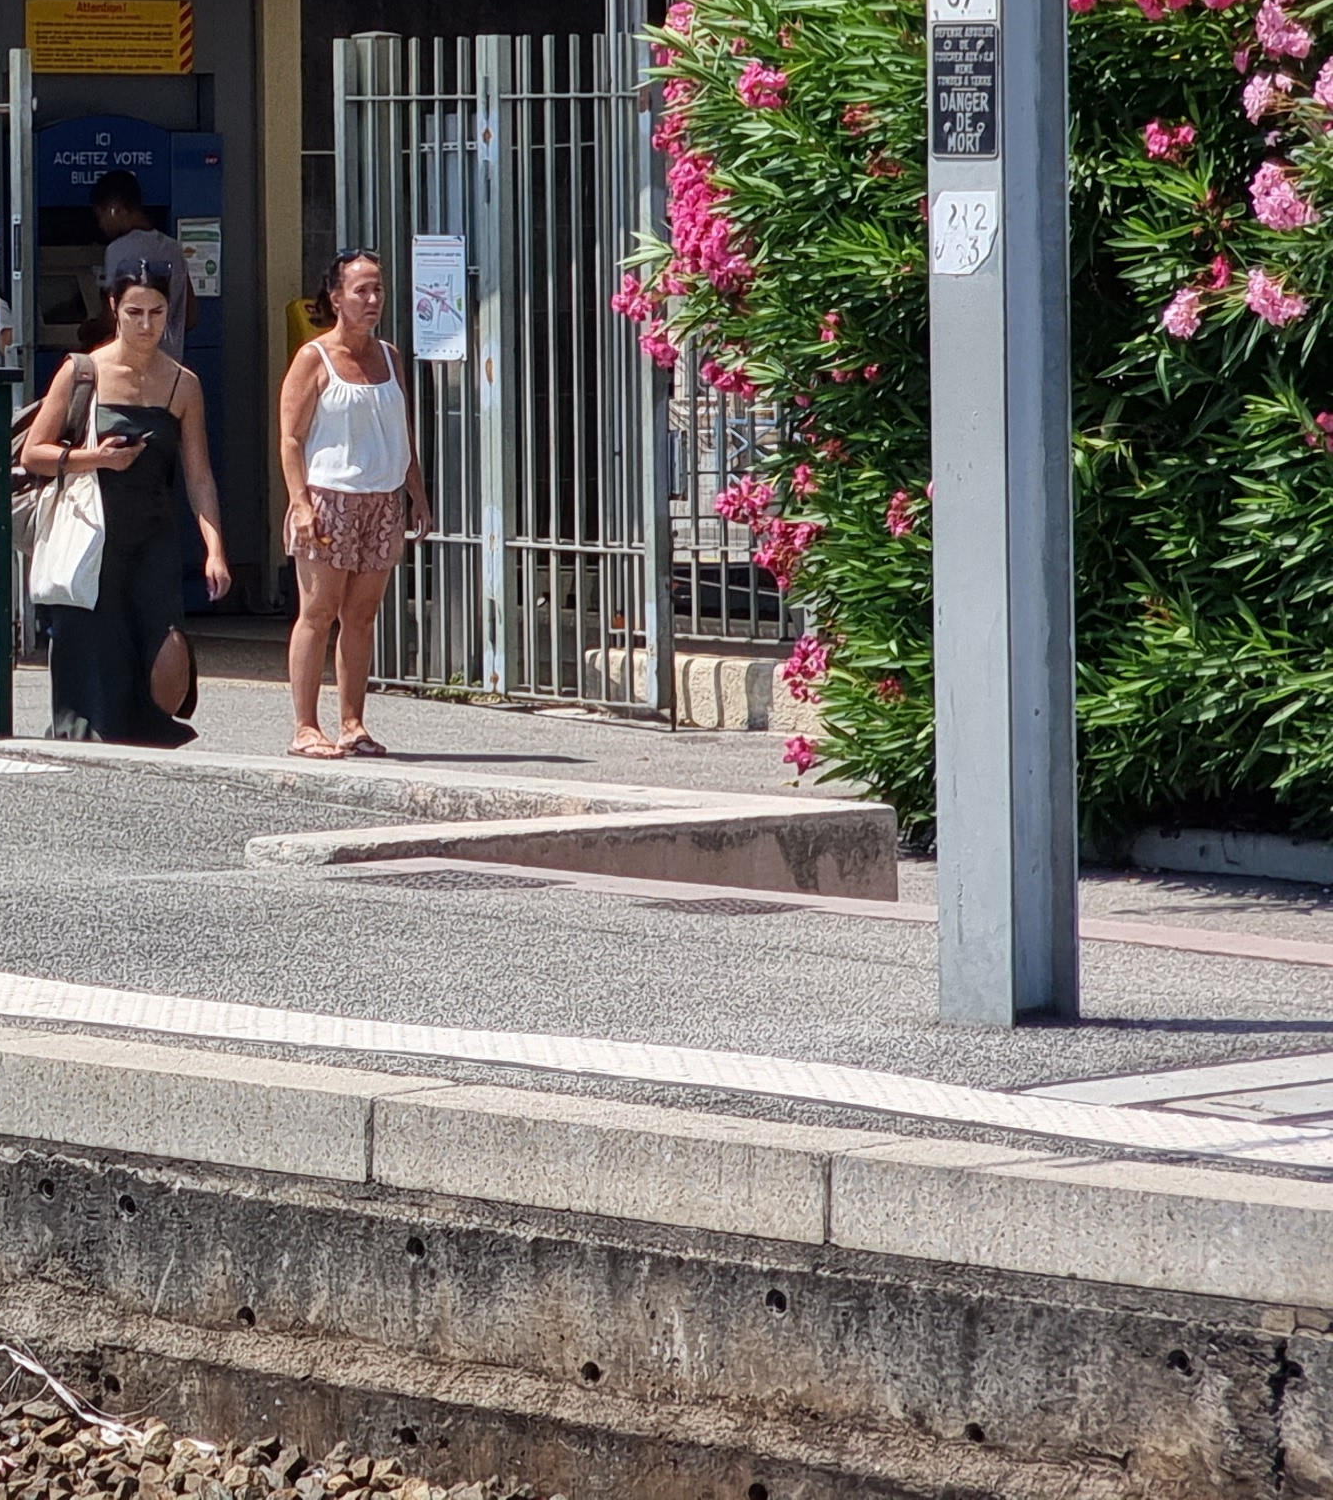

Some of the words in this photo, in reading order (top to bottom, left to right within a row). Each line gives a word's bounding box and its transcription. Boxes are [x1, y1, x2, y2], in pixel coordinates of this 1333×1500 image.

[76, 1, 127, 14] Attention!
[939, 92, 989, 113] DANGER
[956, 112, 974, 133] DE
[96, 133, 111, 146] ICI
[946, 132, 982, 153] MORT
[53, 151, 108, 166] ACHETEZ
[113, 151, 153, 166] VOTRE
[71, 170, 108, 185] BILLE
